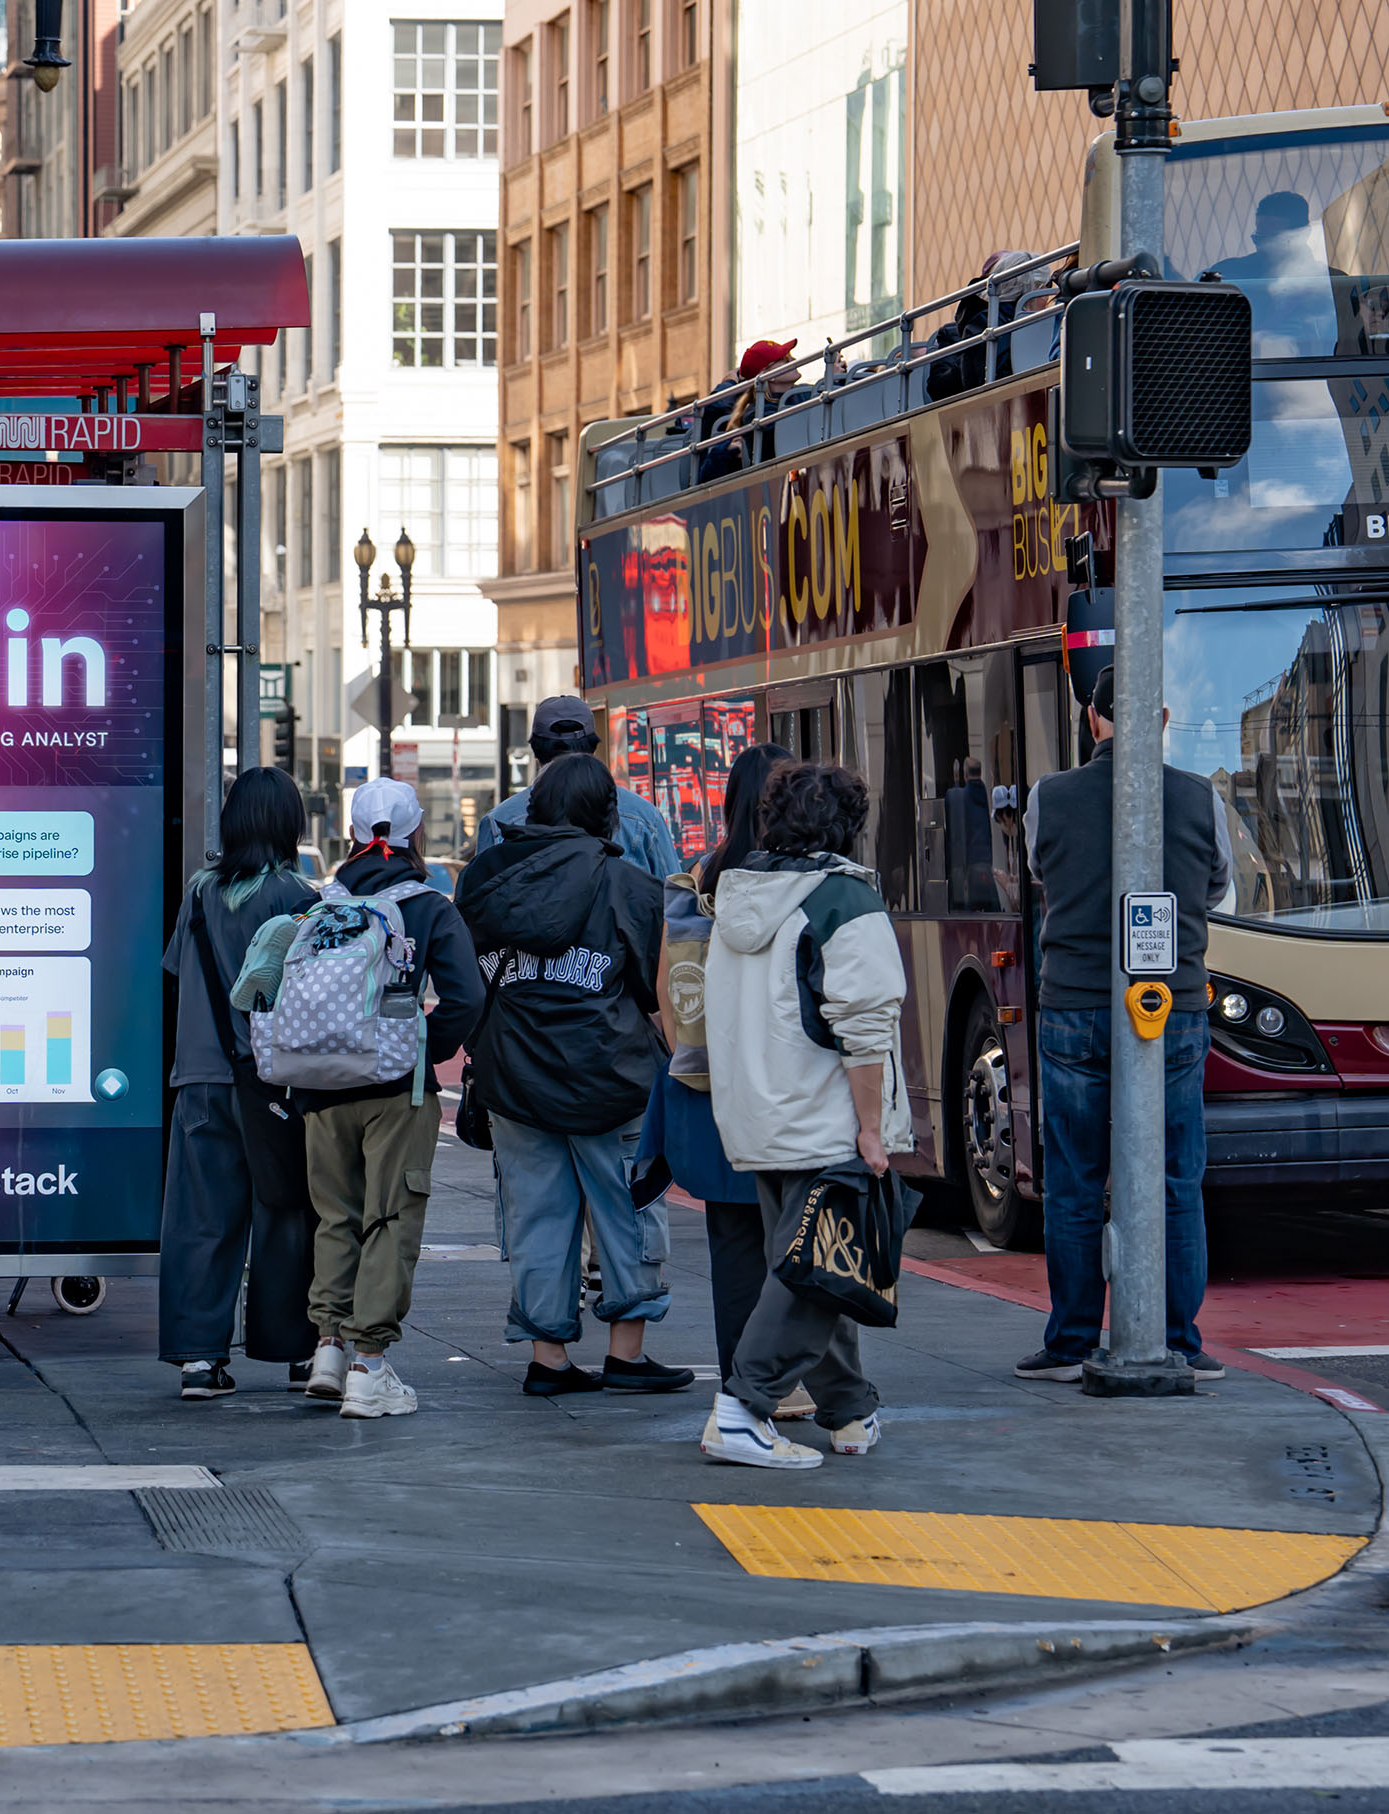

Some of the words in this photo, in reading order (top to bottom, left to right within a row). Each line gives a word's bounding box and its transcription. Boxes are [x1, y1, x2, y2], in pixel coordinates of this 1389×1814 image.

[51, 417, 141, 449] RAPID
[1011, 423, 1048, 505] BIG
[1366, 514, 1389, 539] B
[1013, 506, 1051, 581] BUS
[21, 732, 109, 747] ANALYST
[40, 832, 60, 841] are
[22, 848, 79, 861] pipeline?
[21, 905, 41, 916] the
[44, 906, 76, 916] most
[1132, 930, 1170, 939] ACCESSIBLE
[1137, 942, 1165, 950] MESSAGE
[1142, 954, 1160, 962] ONLY
[478, 948, 540, 987] NEW
[544, 946, 611, 992] YORK
